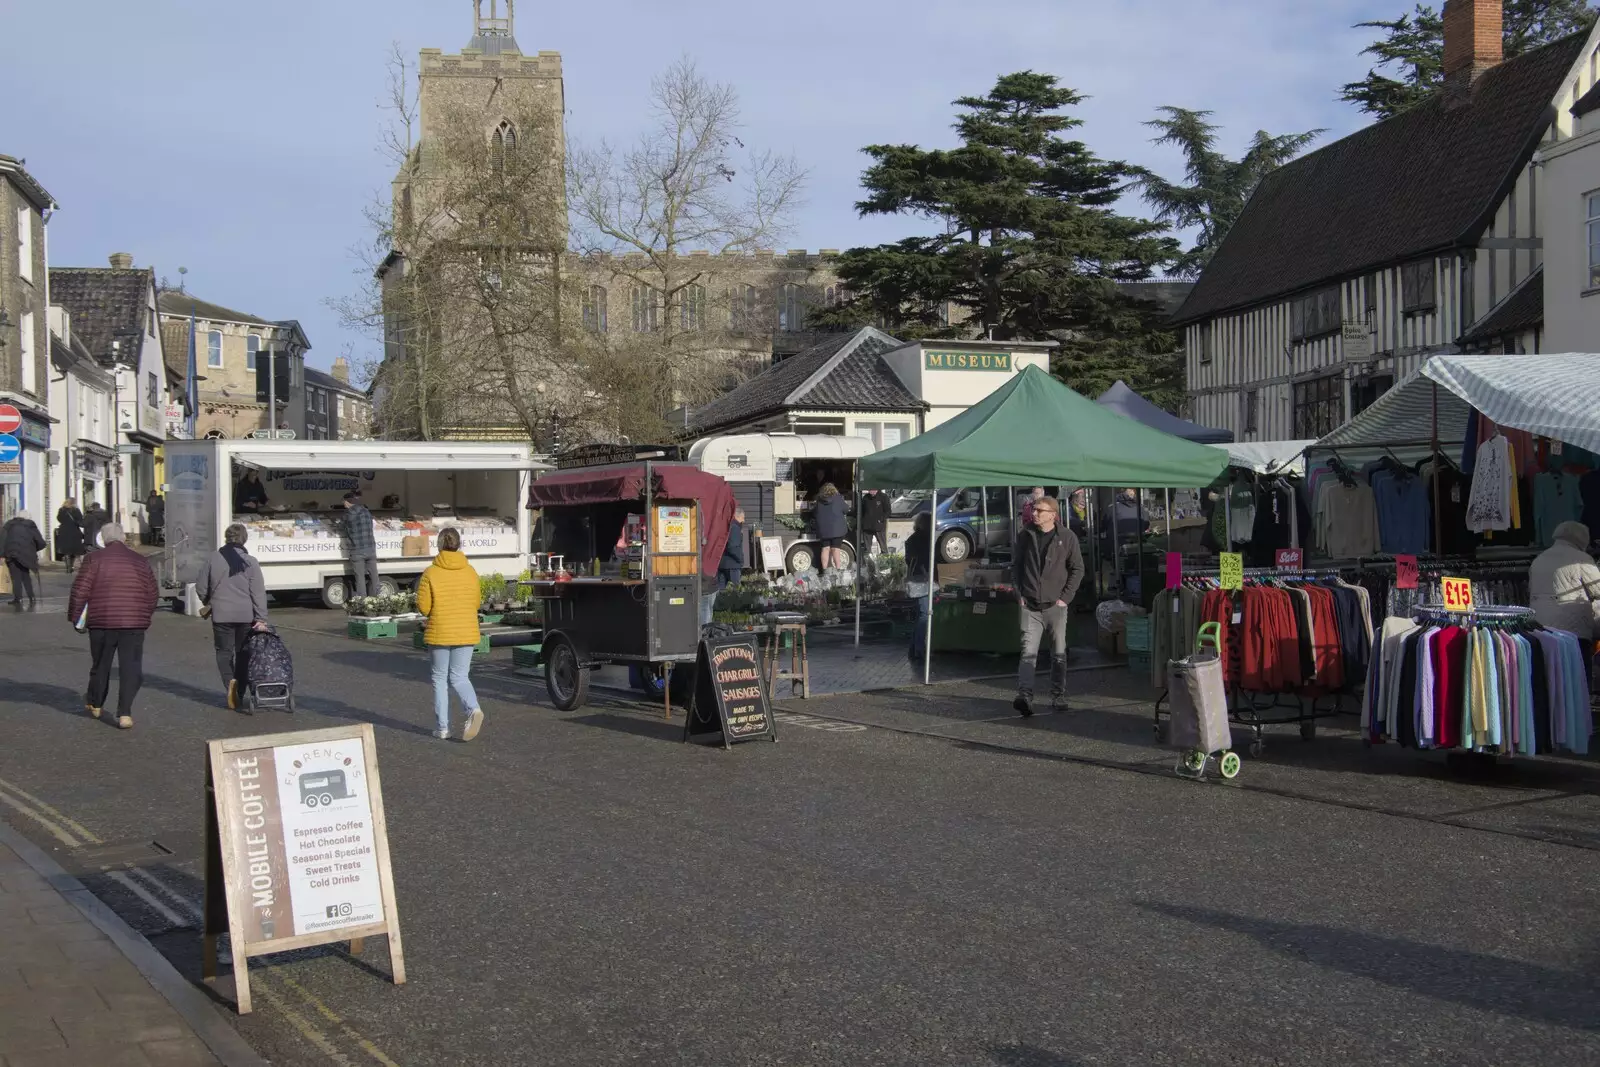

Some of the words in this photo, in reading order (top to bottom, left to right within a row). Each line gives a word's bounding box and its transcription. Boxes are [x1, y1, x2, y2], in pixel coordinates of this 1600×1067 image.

[1344, 333, 1368, 341] Cottage
[929, 354, 1008, 368] MUSEUM
[258, 544, 285, 553] FINEST
[288, 543, 315, 552] FRESH
[317, 542, 336, 551] FISH
[469, 539, 498, 547] WORLD
[1279, 551, 1299, 563] Sale
[1445, 581, 1470, 605] £15
[712, 648, 756, 664] TRADITIONAL
[723, 686, 760, 701] SAUSAGES
[733, 706, 747, 714] MADE
[727, 716, 737, 725] OUR
[737, 715, 748, 724] OWN
[748, 713, 764, 723] RECIPE
[238, 756, 265, 830] COFFEE
[293, 826, 333, 838] Espresso
[335, 820, 364, 831] Coffee
[299, 841, 315, 850] Hot
[317, 835, 361, 847] Chocolate
[292, 852, 332, 864] Seasonal
[335, 846, 371, 858] Specials
[246, 833, 275, 907] MOBILE
[305, 866, 332, 876] Sweet
[334, 861, 362, 872] Treats
[309, 878, 330, 889] Cold
[332, 874, 360, 886] Drinks
